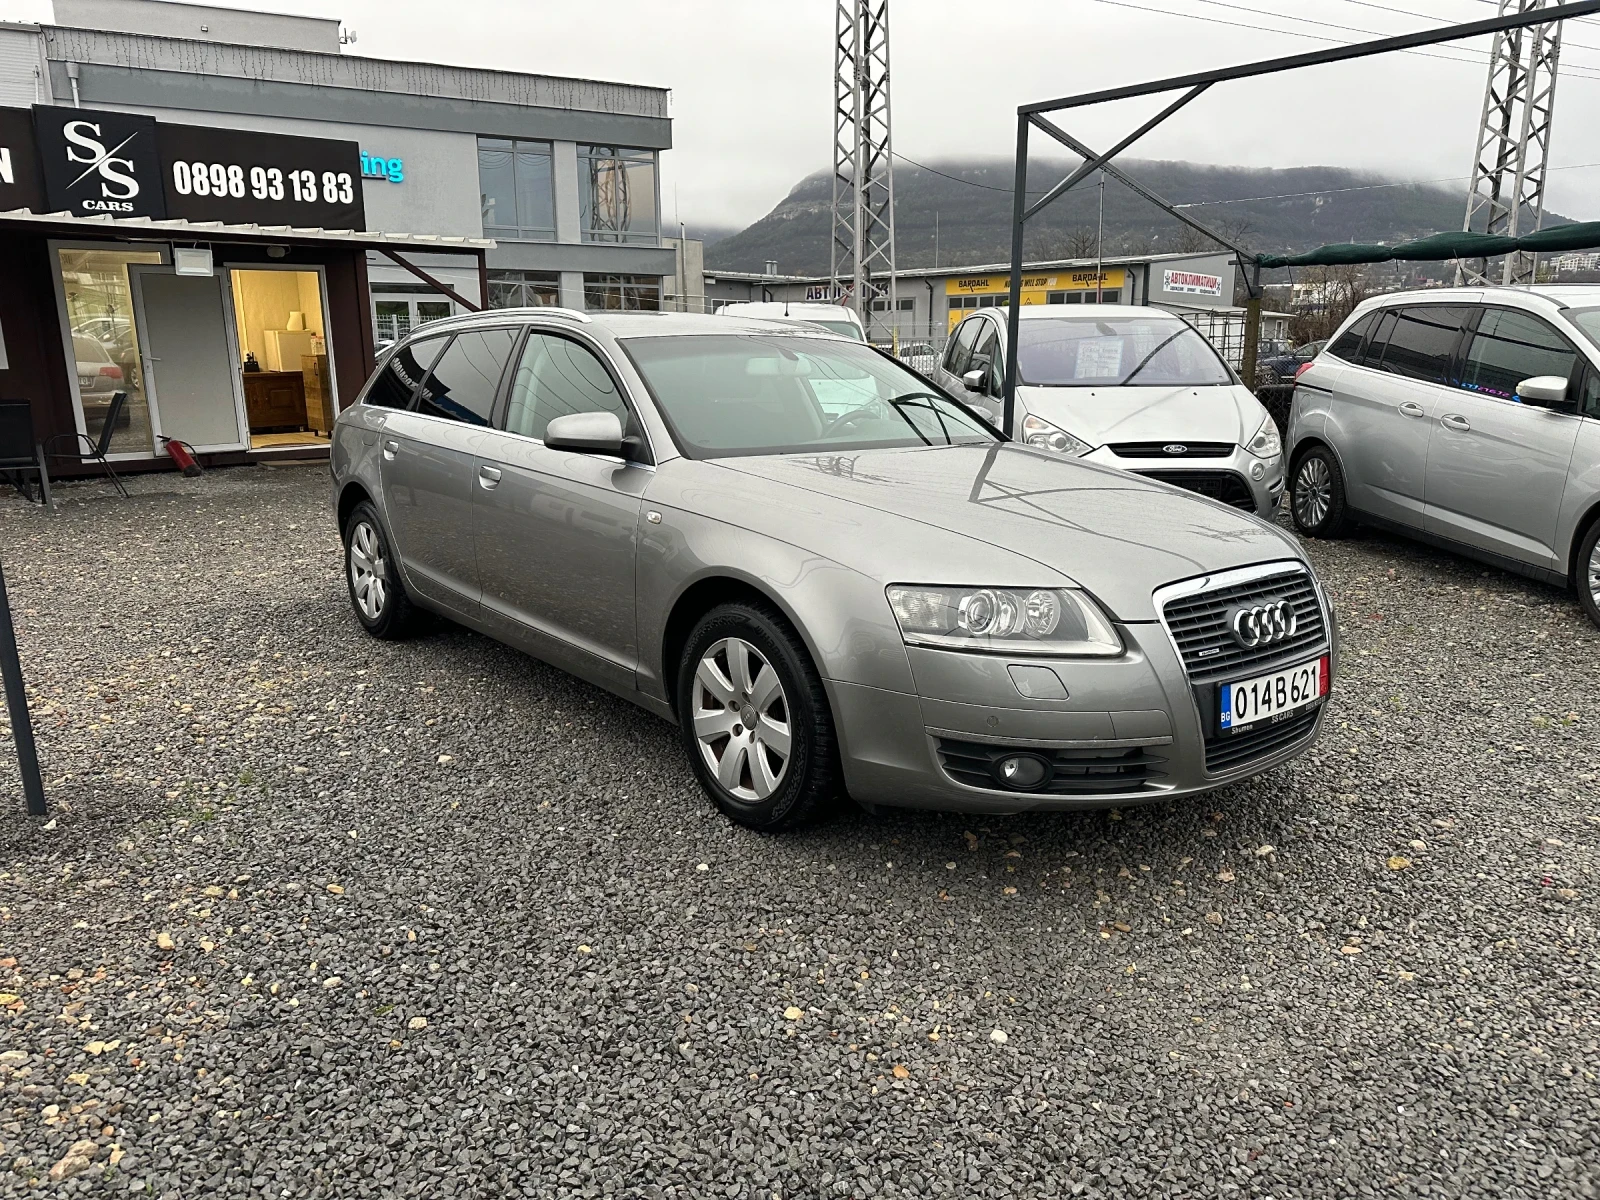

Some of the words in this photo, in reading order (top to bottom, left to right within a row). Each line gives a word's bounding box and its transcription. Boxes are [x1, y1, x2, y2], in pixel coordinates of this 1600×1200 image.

[361, 150, 404, 183] ing
[173, 160, 246, 198] 0898
[251, 166, 285, 201] 93
[288, 169, 318, 203] 13
[322, 171, 353, 204] 83
[82, 200, 134, 212] CARS
[958, 279, 990, 290] BARDAHL
[1035, 277, 1048, 287] STOP
[1235, 665, 1317, 719] 014B621
[1220, 711, 1231, 723] BG
[1271, 715, 1279, 724] SS
[1279, 709, 1294, 721] CARS
